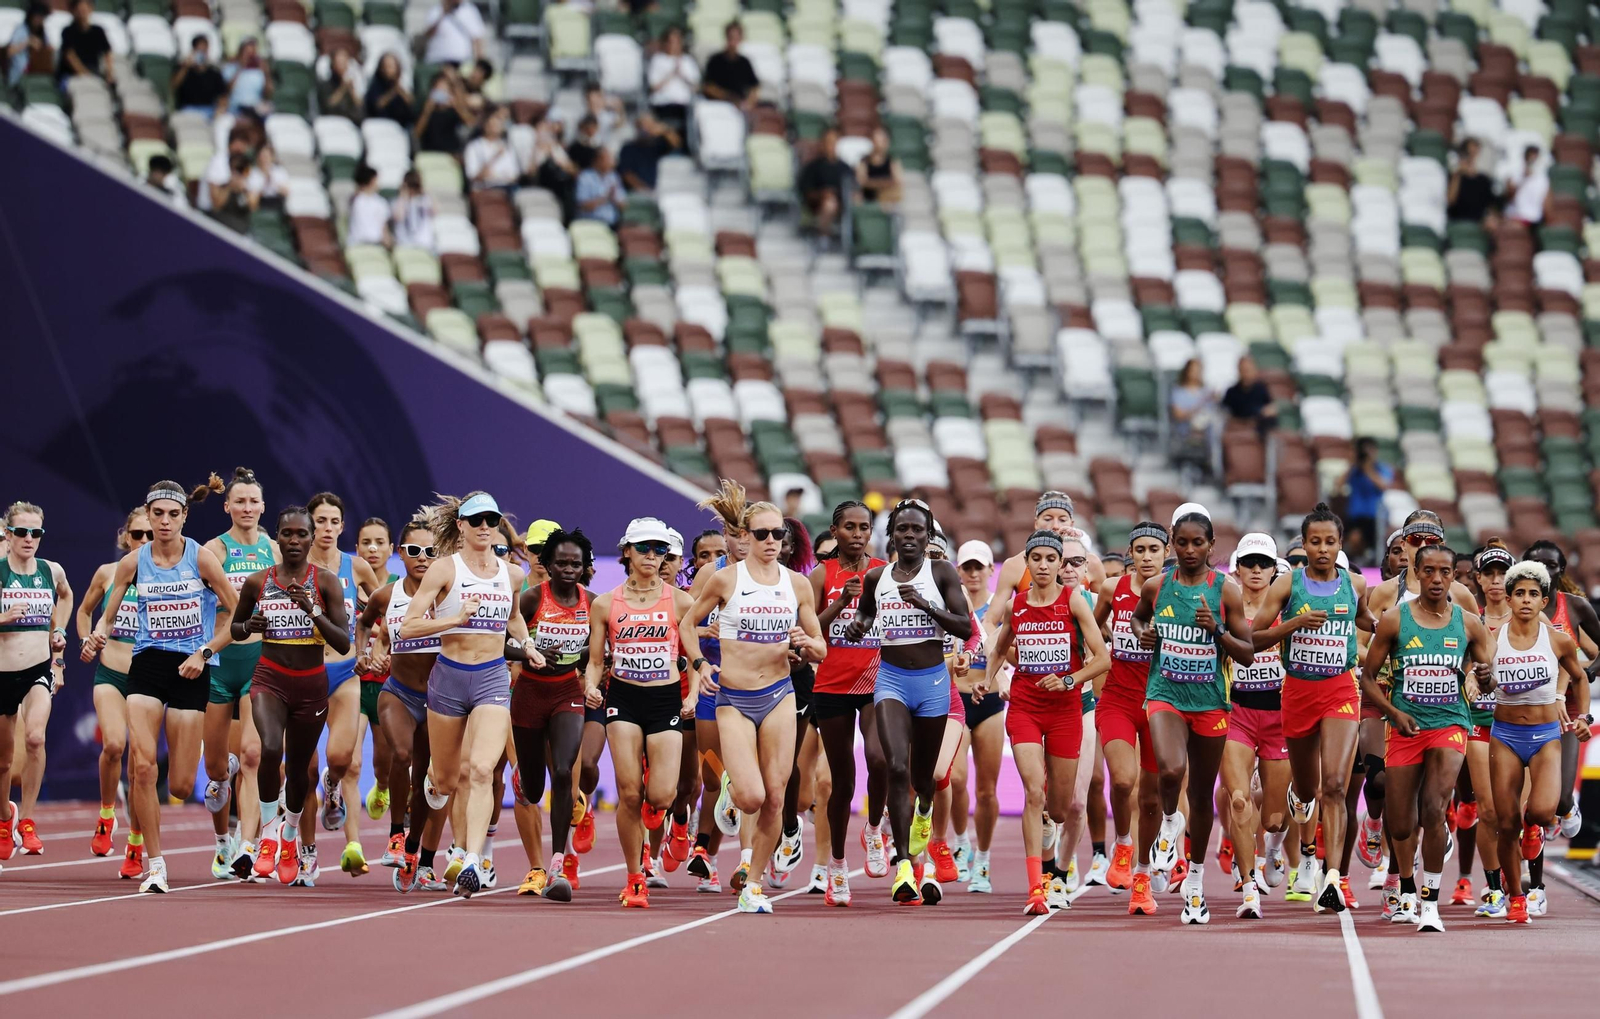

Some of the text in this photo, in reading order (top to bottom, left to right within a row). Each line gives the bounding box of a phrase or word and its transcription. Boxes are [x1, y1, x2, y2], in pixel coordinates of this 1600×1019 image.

[147, 583, 189, 594] URUGUAY
[461, 592, 512, 603] HONDA
[148, 601, 199, 613] HONDA
[261, 602, 300, 611] HOND
[476, 605, 510, 619] CLAIN
[740, 606, 793, 614] HONDA
[881, 602, 914, 610] HON
[150, 612, 200, 629] PATERNAIN
[268, 614, 311, 628] HESANG
[740, 618, 792, 631] SULLIVAN
[882, 614, 933, 628] SALPETER
[1017, 621, 1065, 632] MOROCCO
[162, 627, 200, 637] TOKYO25
[539, 625, 588, 636] HONDA
[615, 625, 669, 640] JAPAN
[1017, 637, 1069, 646] HONDA
[1293, 635, 1345, 647] HONDA
[616, 645, 669, 655] HONDA
[1162, 643, 1216, 655] HONDA
[1020, 649, 1069, 662] FARKOUSSI
[1254, 655, 1280, 664] NDA
[1292, 648, 1344, 665] KETEMA
[1497, 655, 1547, 665] HONDA
[621, 657, 665, 670] ANDO
[1162, 656, 1213, 672] ASSEFA
[1171, 673, 1214, 681] TOKYO25
[1237, 666, 1280, 681] CIREN
[1405, 668, 1458, 677] HONDA
[1498, 666, 1549, 683] TIYOURI
[1407, 680, 1456, 694] KEBEDE
